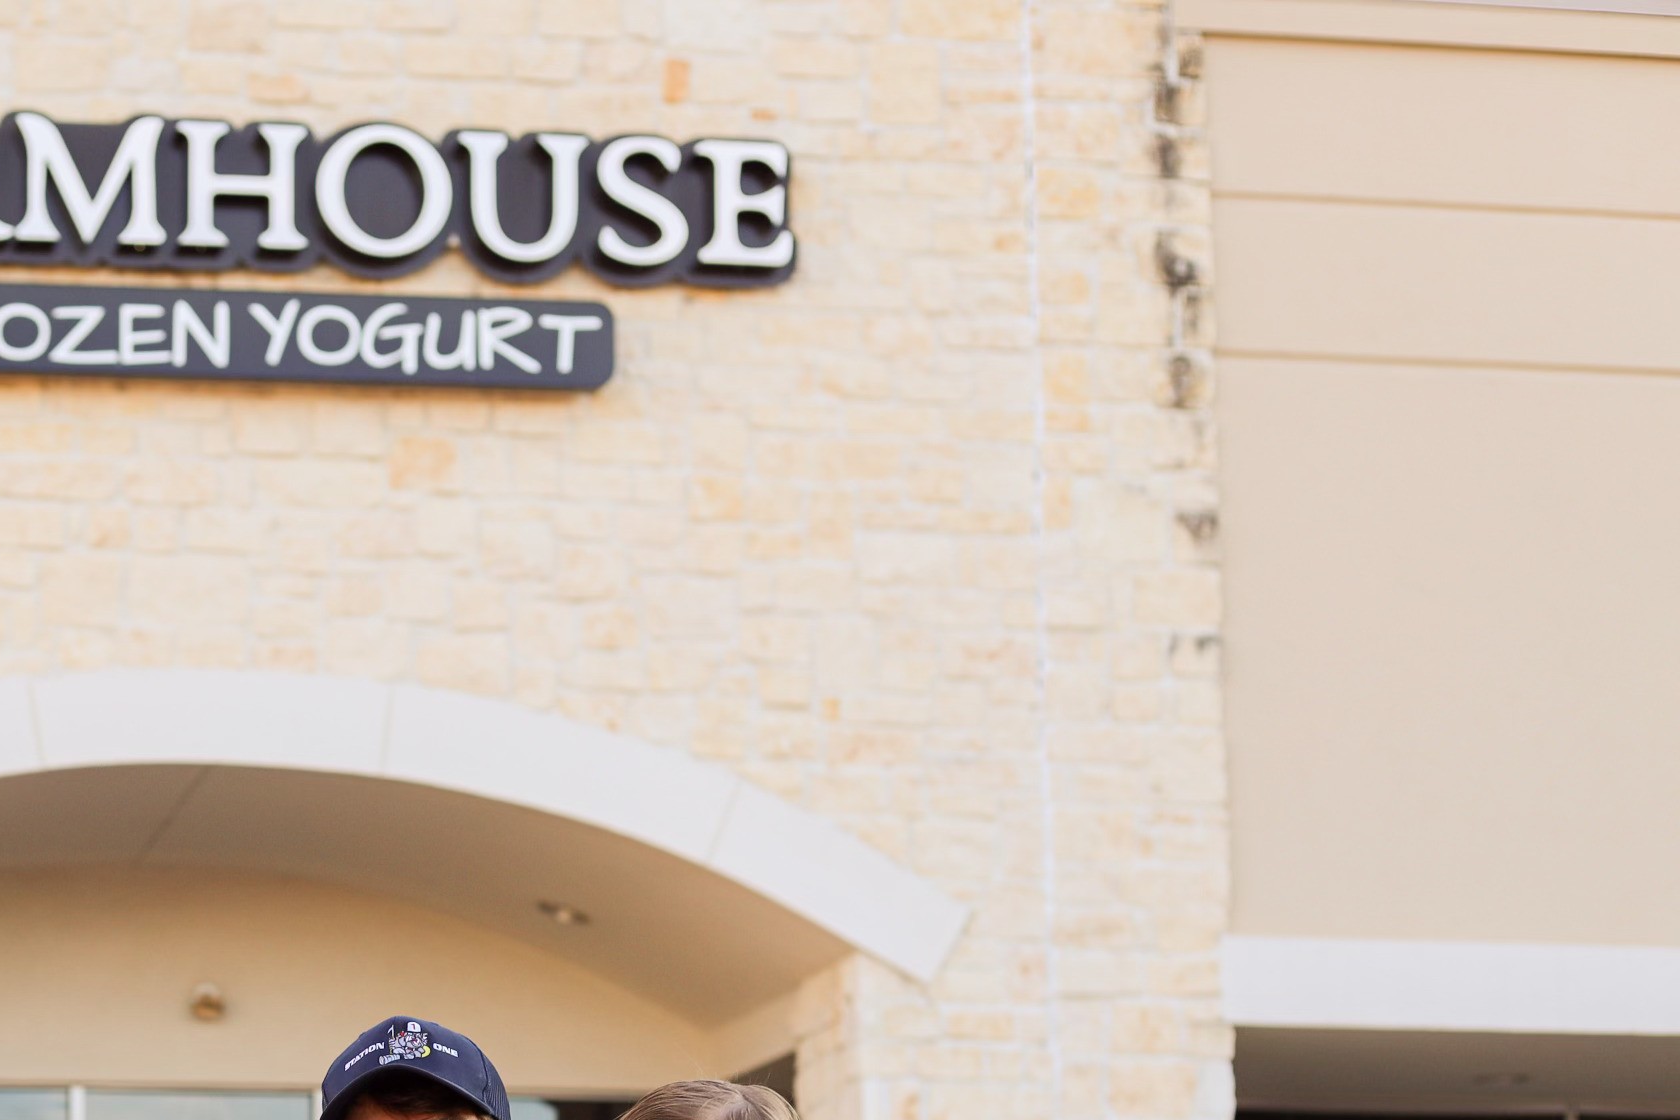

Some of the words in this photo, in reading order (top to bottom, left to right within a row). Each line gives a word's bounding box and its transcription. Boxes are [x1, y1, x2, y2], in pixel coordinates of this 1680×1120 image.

[247, 298, 603, 374] YOGURT
[344, 1042, 385, 1071] STATION
[433, 1042, 459, 1058] ONE
